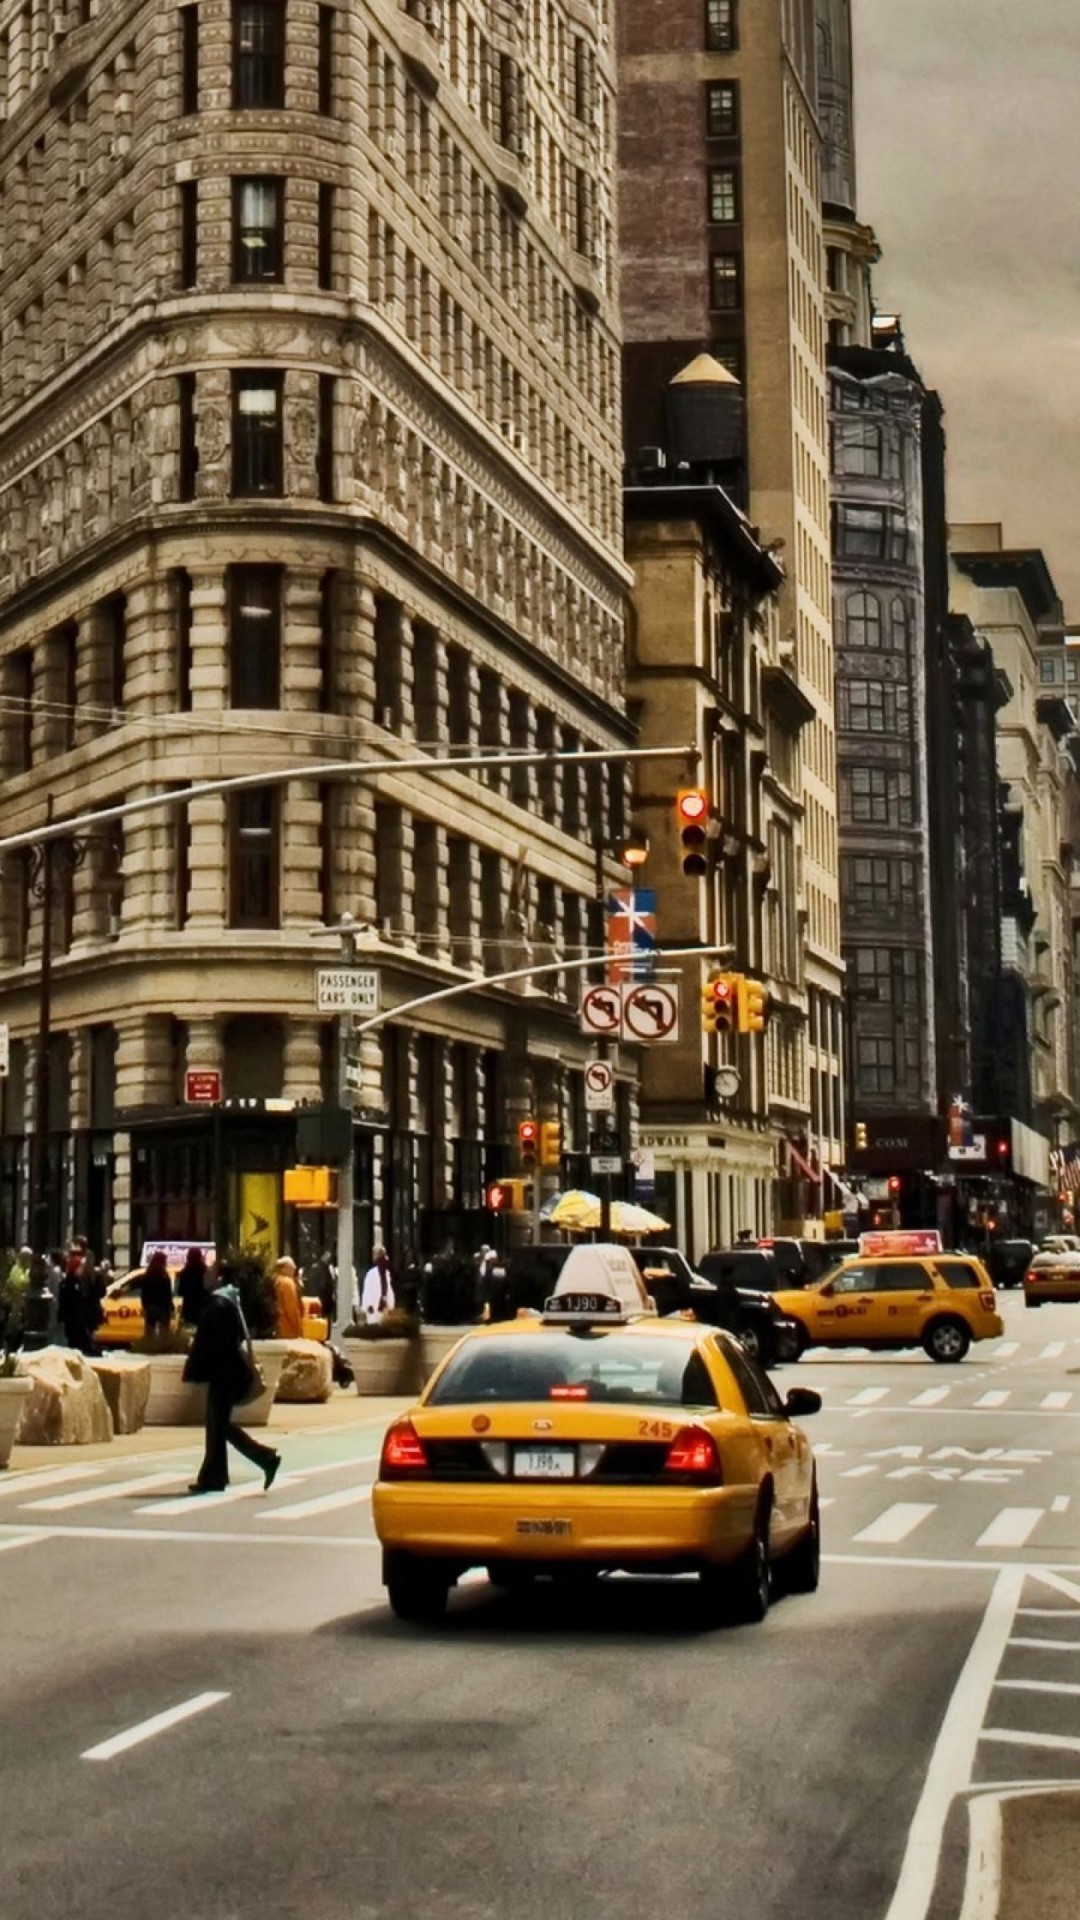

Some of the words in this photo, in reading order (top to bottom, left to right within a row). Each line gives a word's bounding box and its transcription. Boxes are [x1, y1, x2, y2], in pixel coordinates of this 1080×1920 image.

[320, 974, 375, 988] PASSENGER
[320, 991, 346, 1004] CARS
[351, 991, 375, 1005] ONLY
[566, 1296, 598, 1311] 1J90
[638, 1419, 673, 1438] 245
